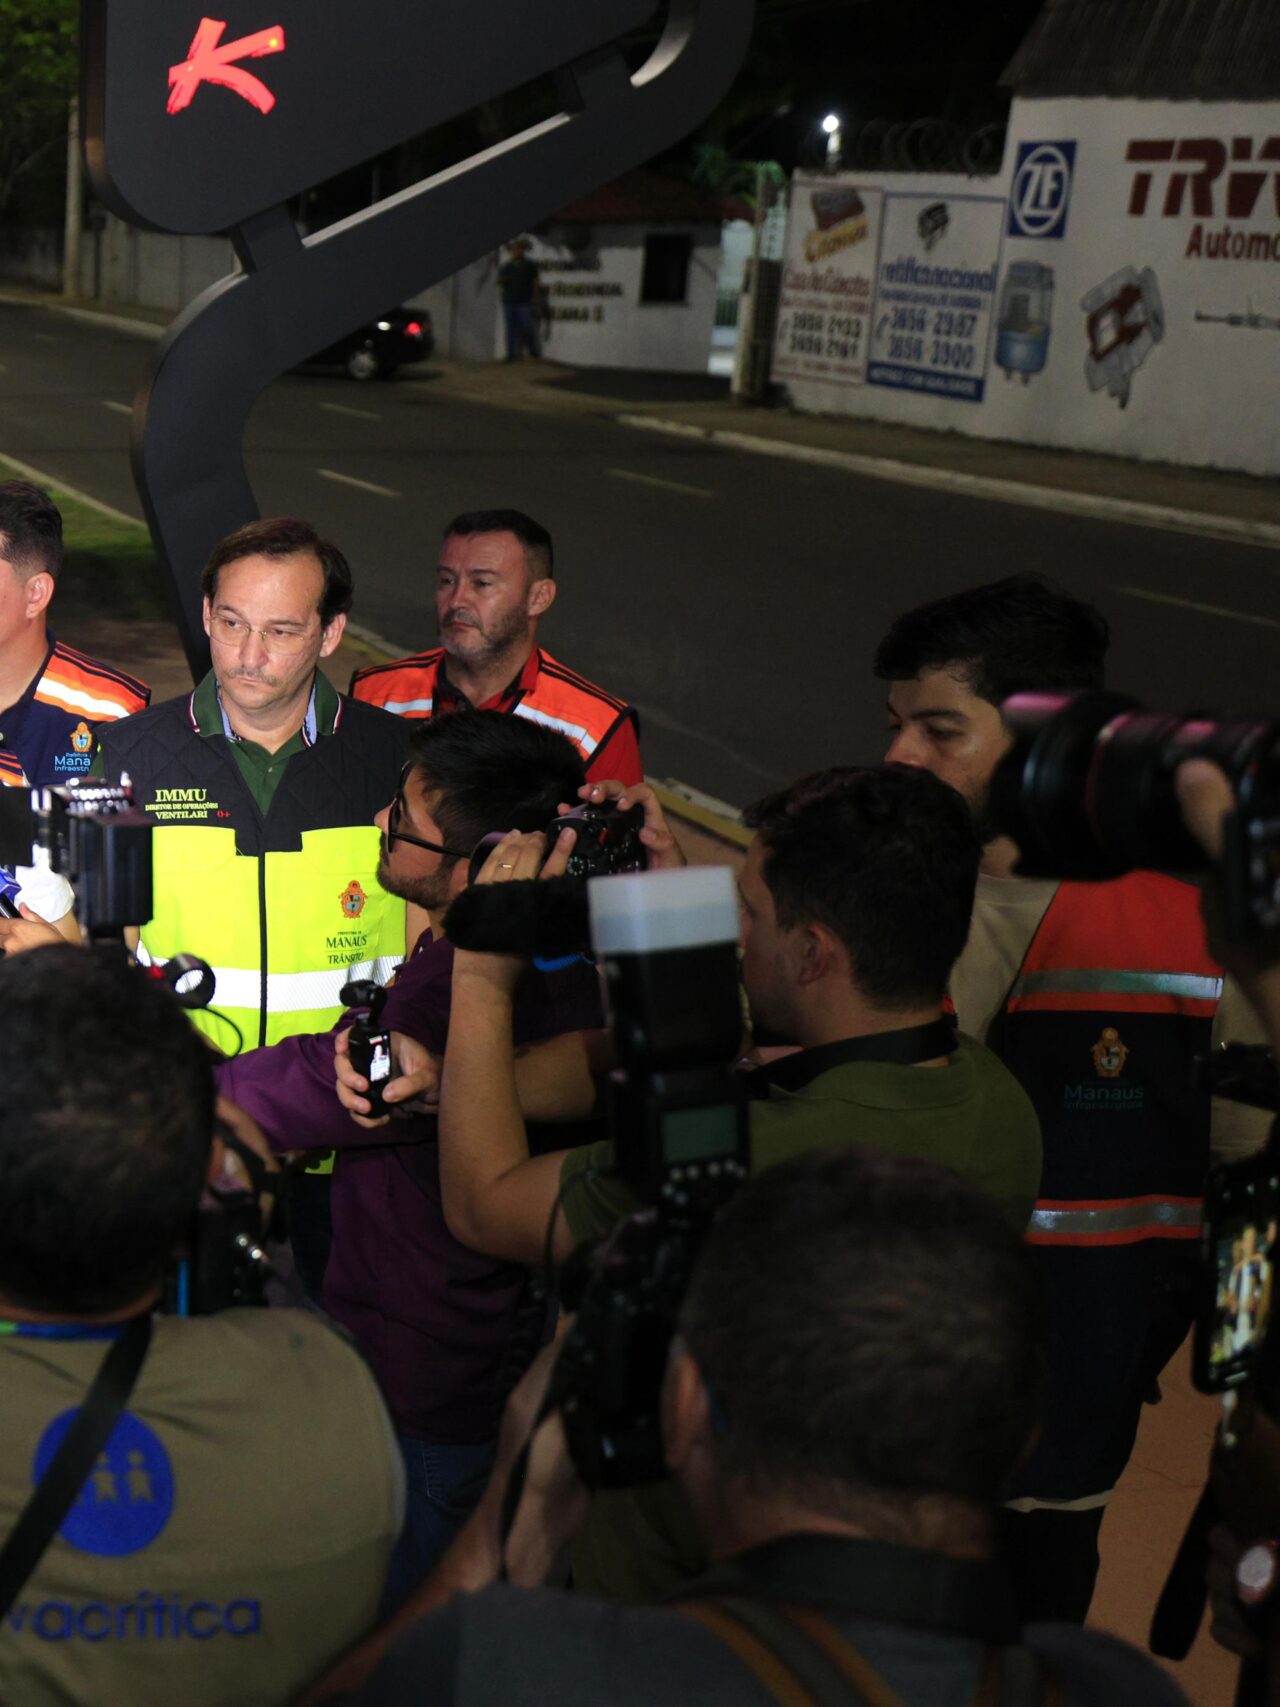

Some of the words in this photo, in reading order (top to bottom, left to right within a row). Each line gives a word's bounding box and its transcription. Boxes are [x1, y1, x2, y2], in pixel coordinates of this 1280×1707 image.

[54, 755, 91, 767] Mana
[155, 788, 207, 802] IMMU
[144, 803, 172, 812] DIRETOR
[155, 810, 208, 820] VENTILARI
[325, 934, 368, 949] MANAUS
[1063, 1082, 1146, 1101] Manaus
